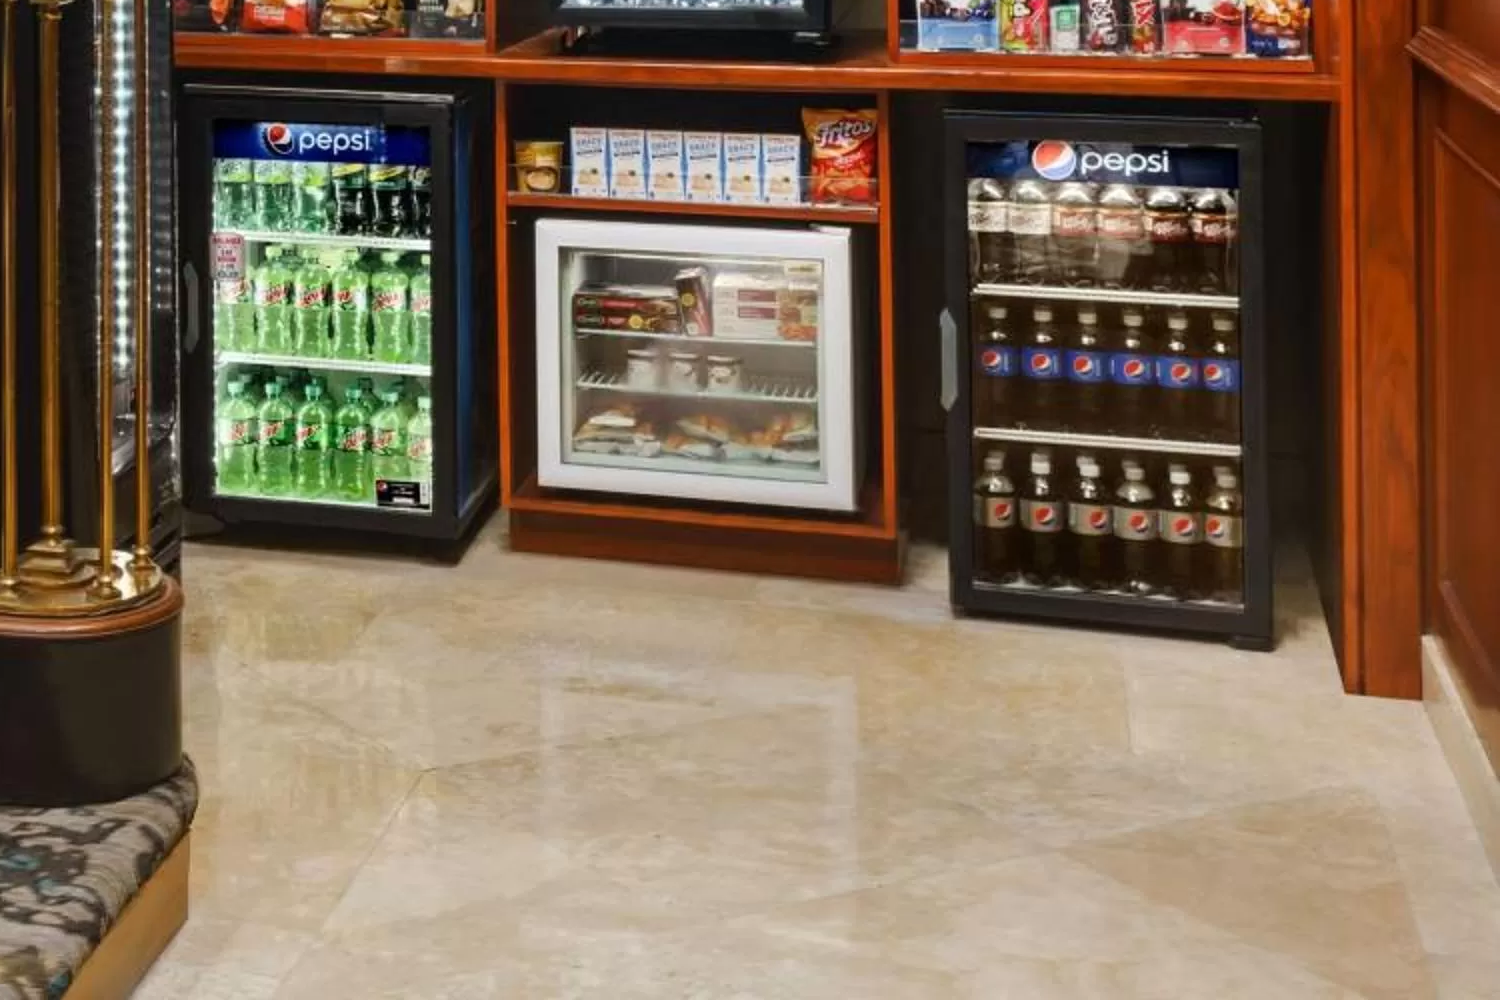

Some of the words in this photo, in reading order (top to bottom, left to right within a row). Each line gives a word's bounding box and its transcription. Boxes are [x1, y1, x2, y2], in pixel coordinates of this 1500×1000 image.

[299, 129, 371, 156] pepsi
[815, 118, 874, 145] Fritos
[1080, 150, 1170, 177] pepsi
